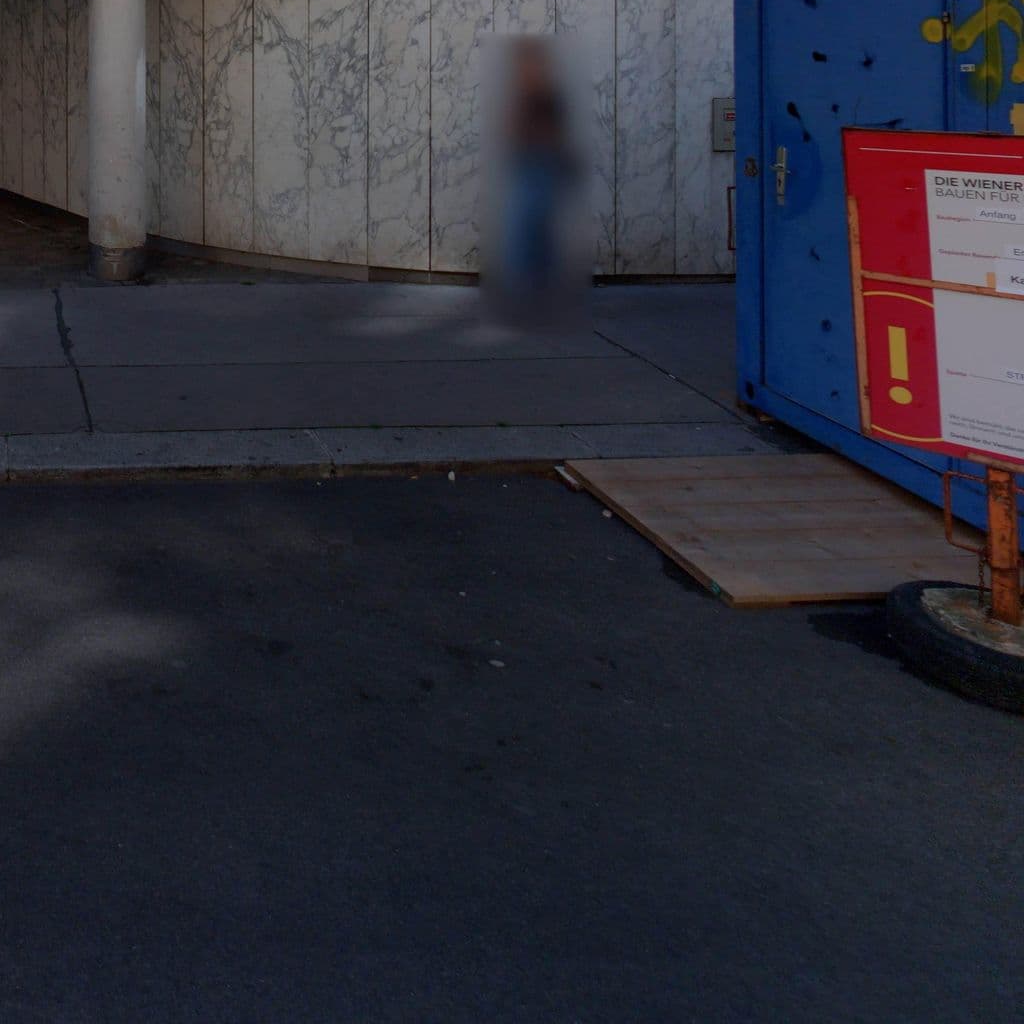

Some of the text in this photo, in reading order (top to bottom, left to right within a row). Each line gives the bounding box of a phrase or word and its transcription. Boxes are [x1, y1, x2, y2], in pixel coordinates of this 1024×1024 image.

[935, 176, 1024, 191] DIE WIENER
[935, 188, 1020, 203] BAUEN FÜR
[979, 210, 1016, 221] Anfang
